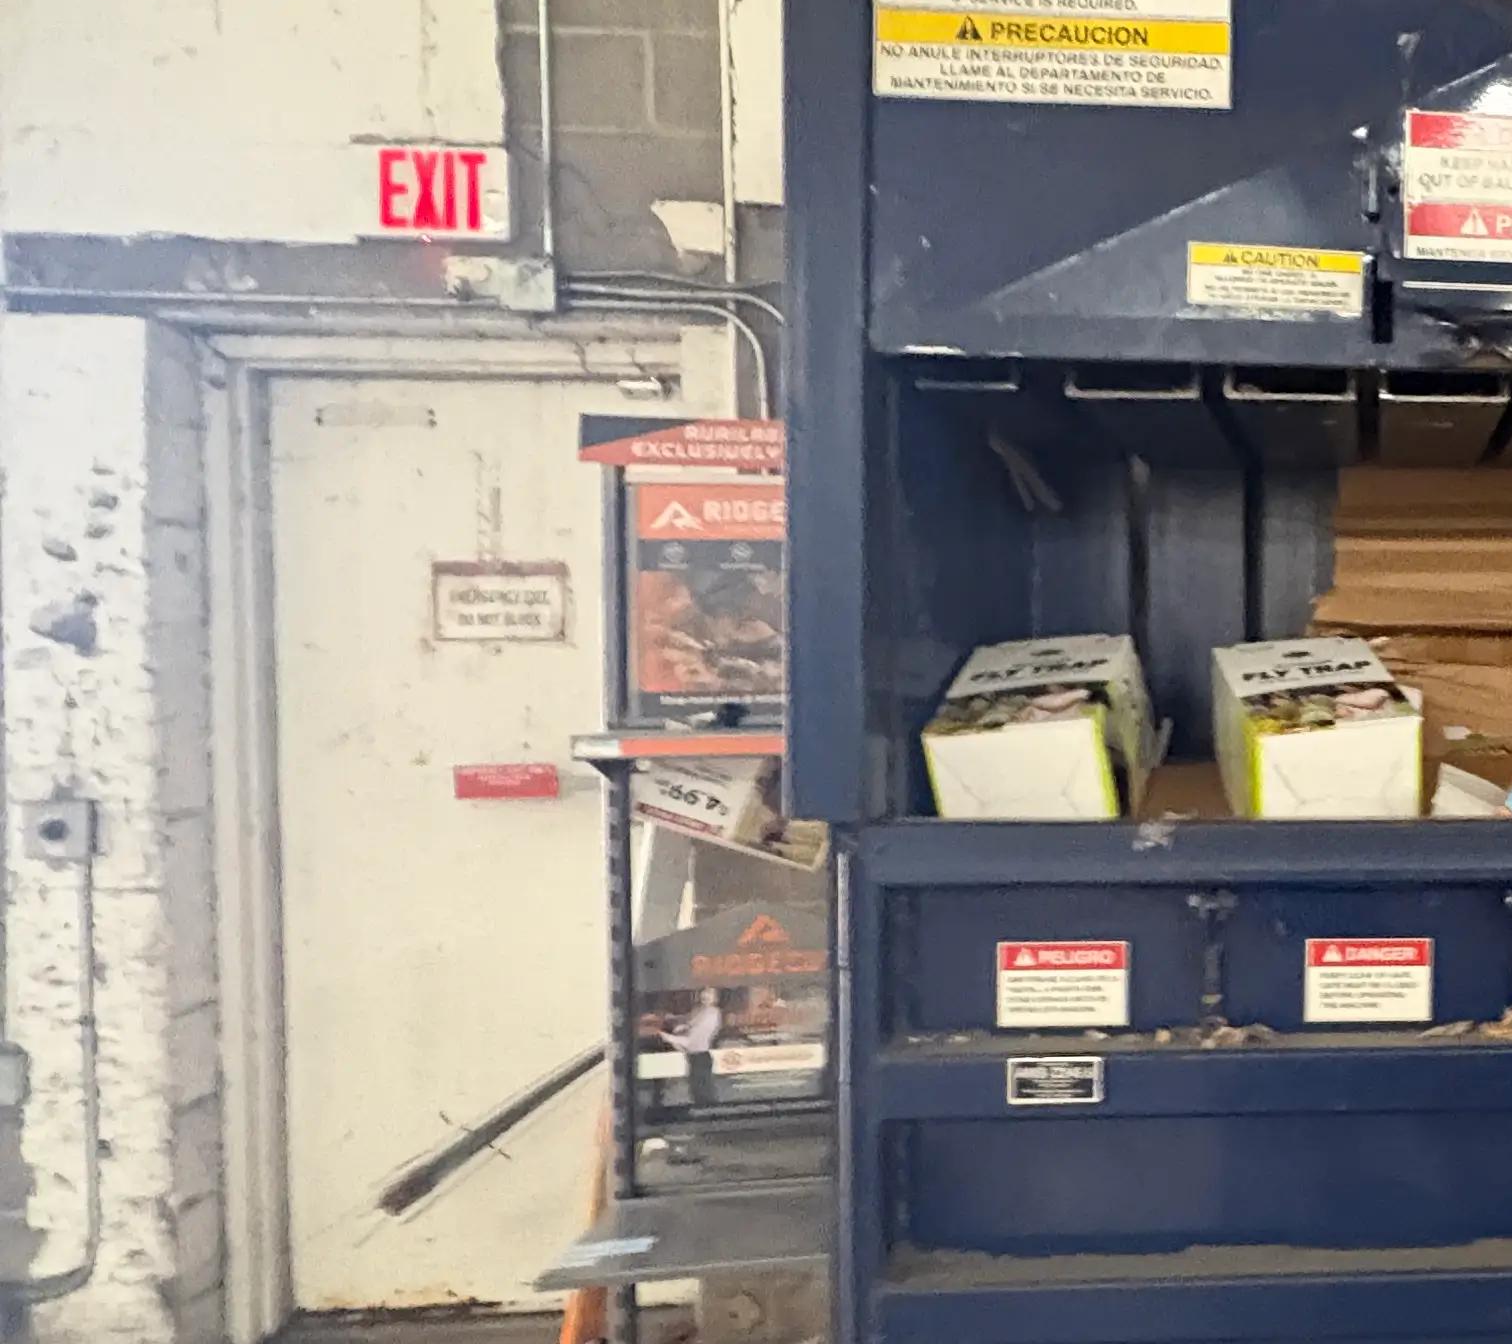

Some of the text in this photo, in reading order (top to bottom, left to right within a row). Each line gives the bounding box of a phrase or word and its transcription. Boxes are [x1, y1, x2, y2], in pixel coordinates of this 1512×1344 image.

[990, 22, 1149, 46] PRECAUCION
[880, 44, 904, 57] NO
[909, 46, 962, 60] ANULE
[966, 48, 1100, 67] INTERRUPTORES
[1103, 54, 1124, 67] DE
[939, 63, 1167, 84] LLAME AL DEPARTAMENTO DE
[891, 76, 1018, 94] MANTENIMIENTO
[1063, 84, 1136, 98] NECESITA
[379, 149, 487, 230] EXIT
[1240, 252, 1320, 268] CAUTION
[631, 440, 783, 460] EXCLUSIVELY
[970, 658, 1109, 681] FLY TRAP
[1242, 660, 1372, 682] FLY TRAP
[1345, 946, 1419, 961] DANGER
